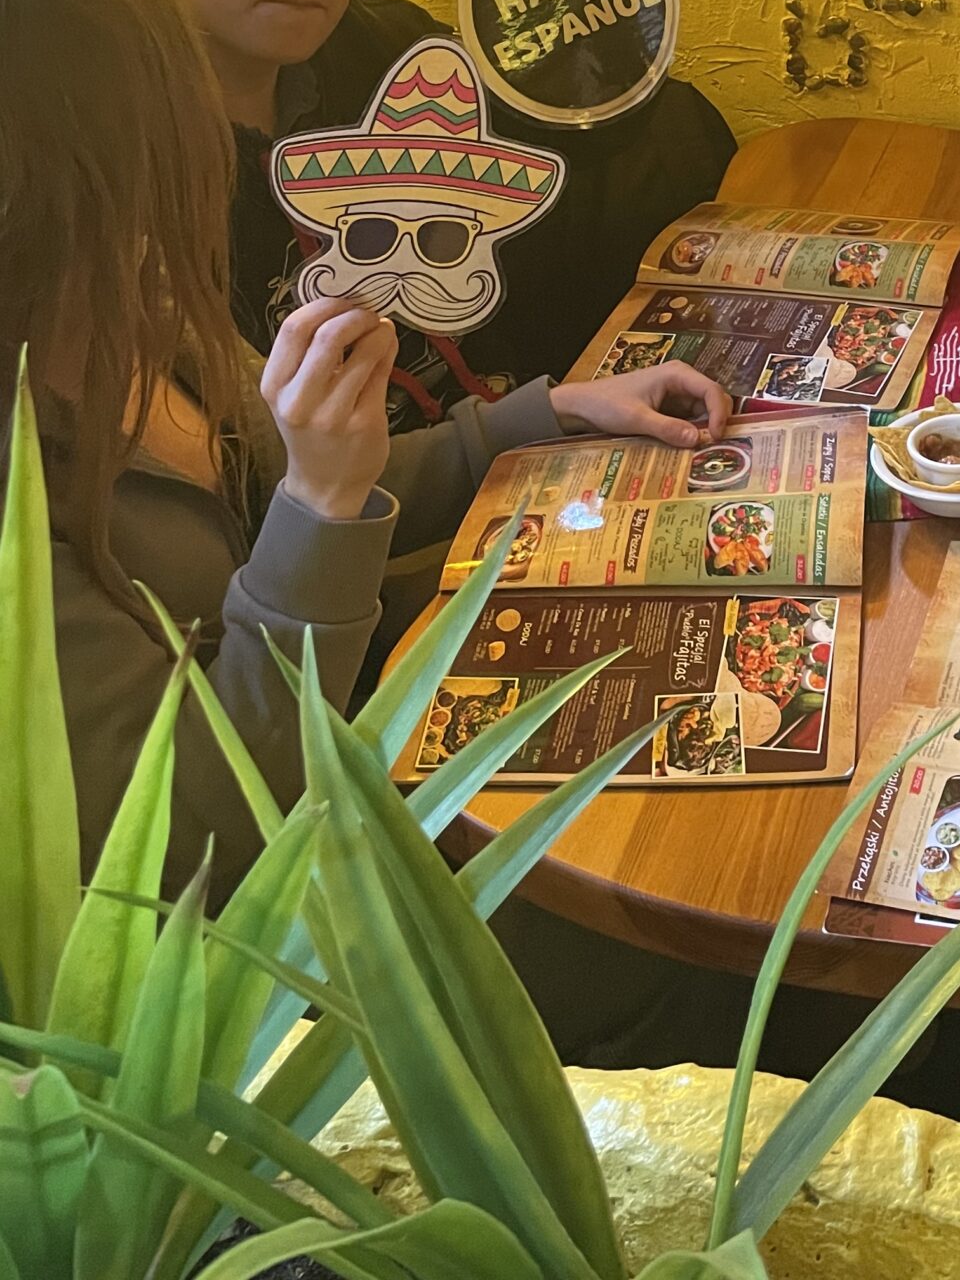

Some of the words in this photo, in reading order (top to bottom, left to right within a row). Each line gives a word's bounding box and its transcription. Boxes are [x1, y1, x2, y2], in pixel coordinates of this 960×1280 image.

[823, 437, 836, 456] Zupy
[627, 533, 643, 568] Pescados
[814, 529, 826, 577] Ensaladas
[519, 622, 533, 646] DODAJ
[699, 619, 711, 629] El
[672, 639, 694, 681] Fajitas
[691, 631, 709, 665] Specjal
[852, 829, 880, 891] Przekąski
[875, 767, 902, 818] Antojito
